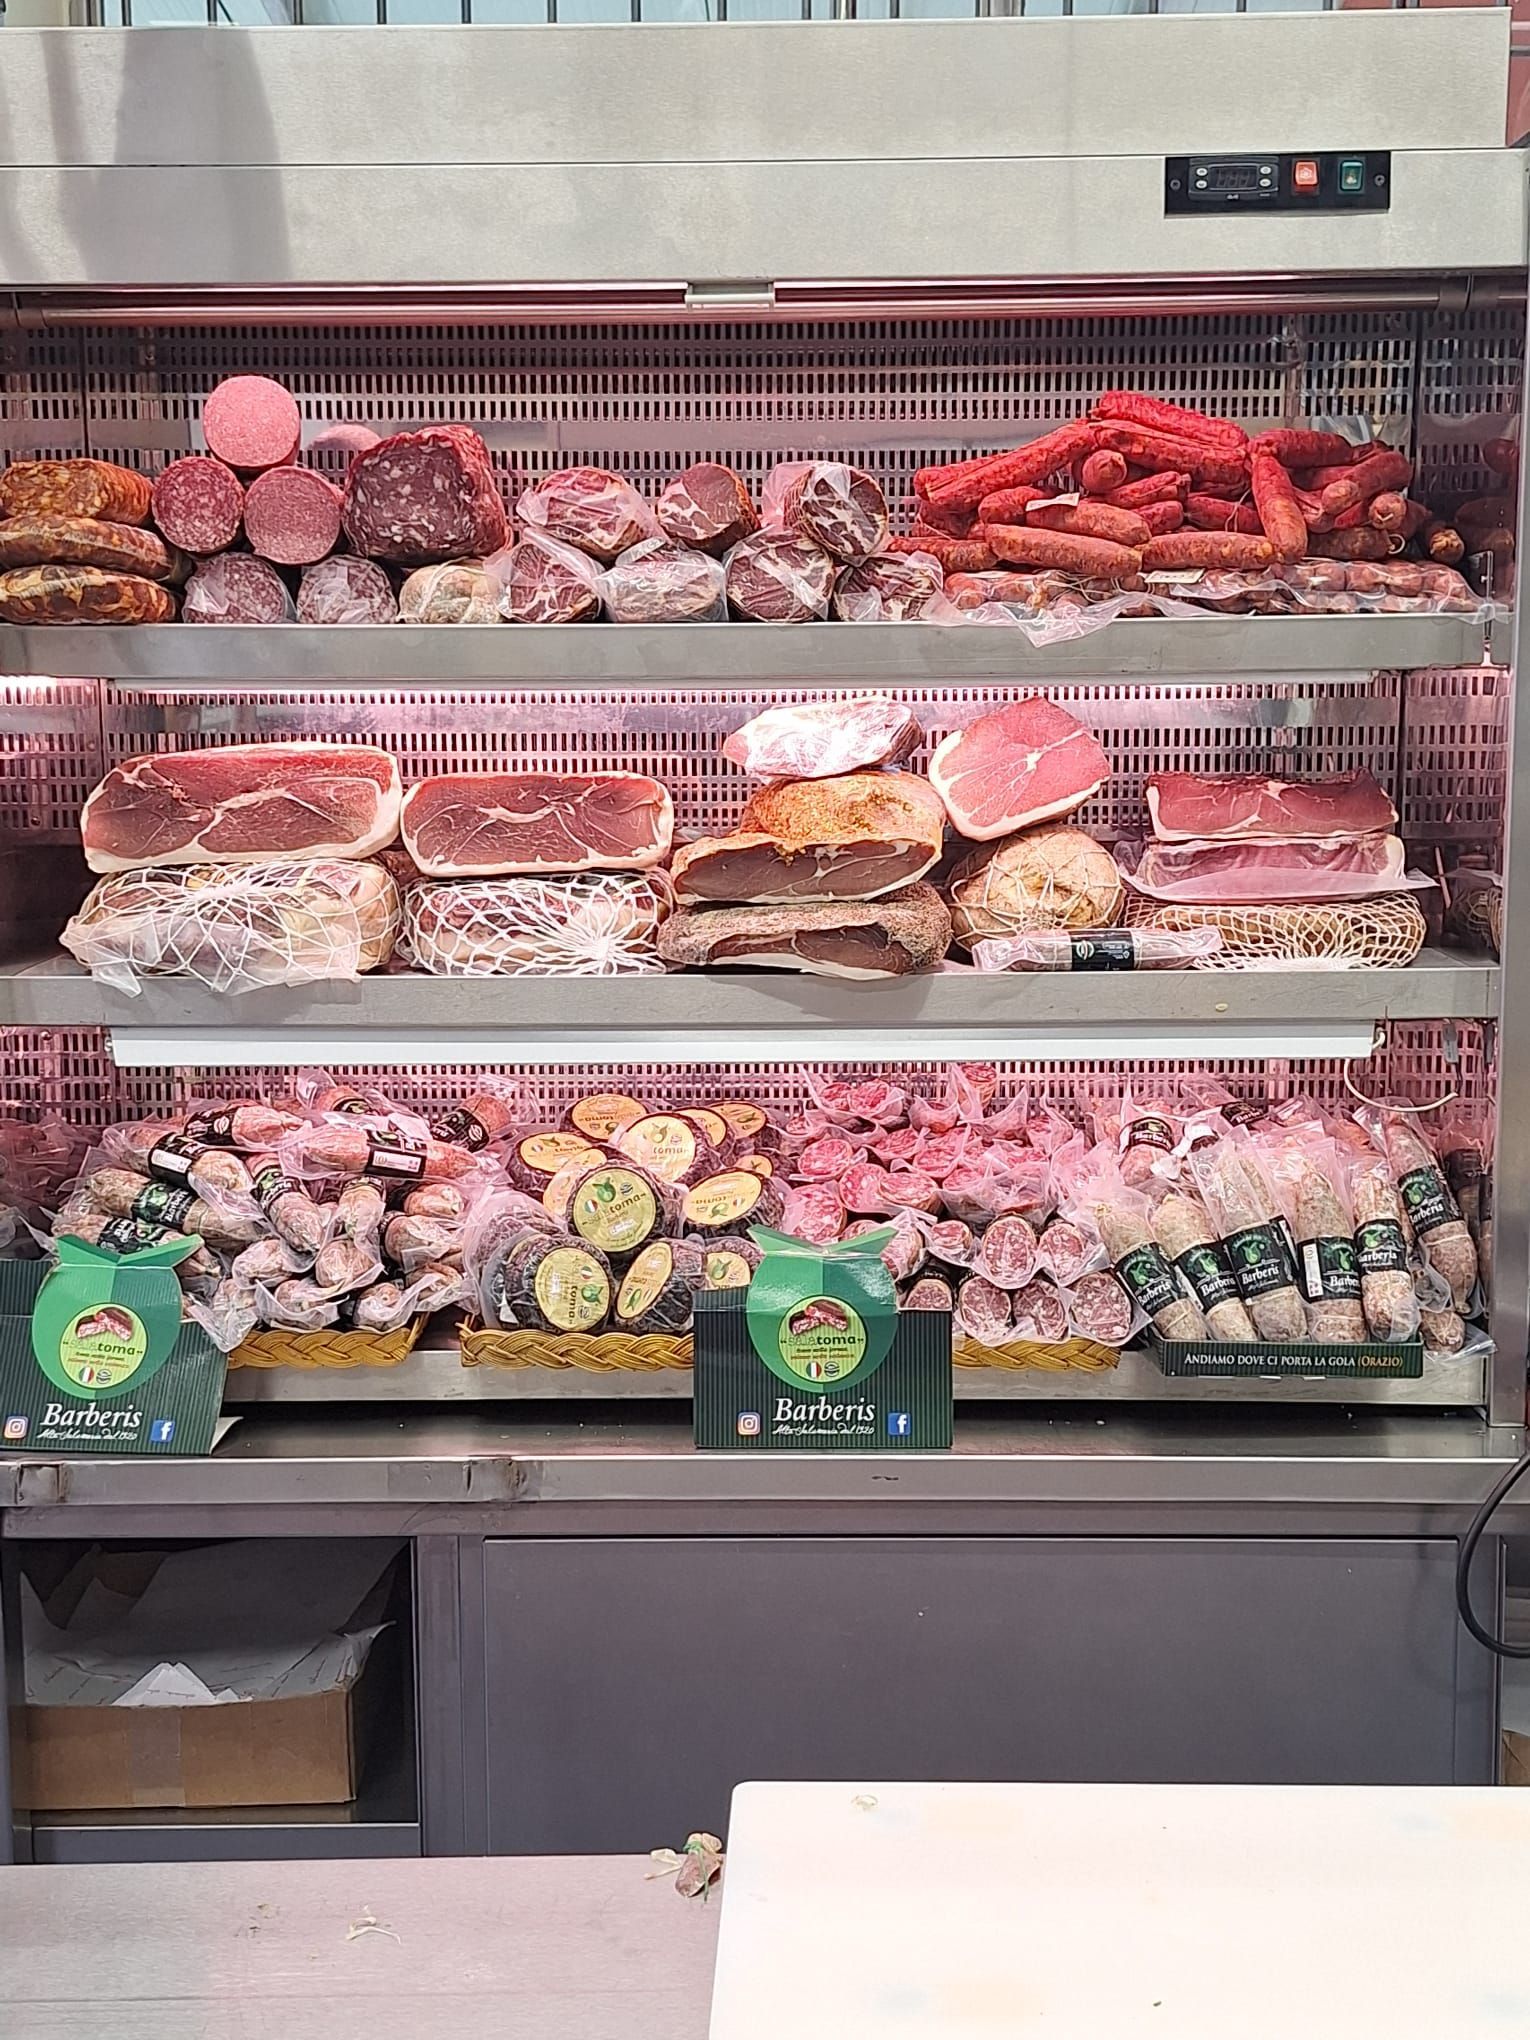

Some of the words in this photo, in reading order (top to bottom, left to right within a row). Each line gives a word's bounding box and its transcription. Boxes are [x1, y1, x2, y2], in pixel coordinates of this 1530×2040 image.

[1184, 1353, 1235, 1365] ANDIAMO
[1237, 1355, 1265, 1365] DOVE
[1267, 1355, 1278, 1365] CI
[1281, 1355, 1312, 1366] PORTA
[1314, 1356, 1326, 1366] LA
[1328, 1356, 1355, 1366] GOLA
[40, 1402, 143, 1427] Barberis
[772, 1396, 876, 1422] Barberis
